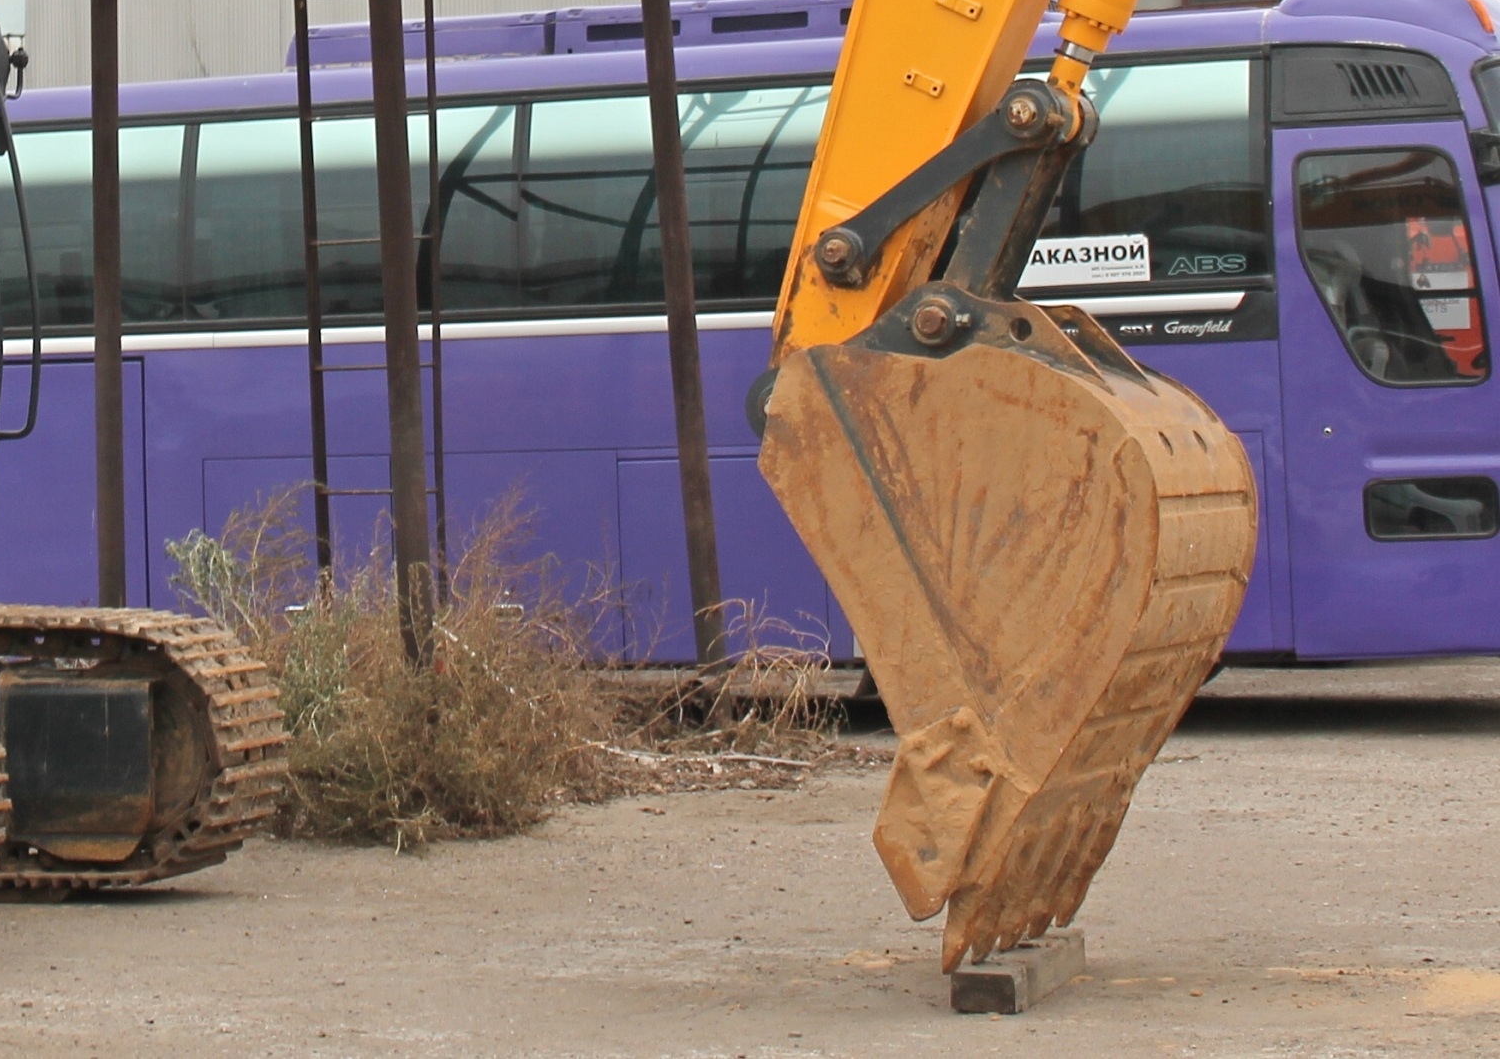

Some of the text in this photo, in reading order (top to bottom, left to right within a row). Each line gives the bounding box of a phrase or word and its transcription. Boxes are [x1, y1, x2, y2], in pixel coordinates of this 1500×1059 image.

[1030, 240, 1145, 266] АКАЗНОЙ
[1168, 254, 1246, 275] ABS
[1164, 320, 1233, 337] Greenfield
